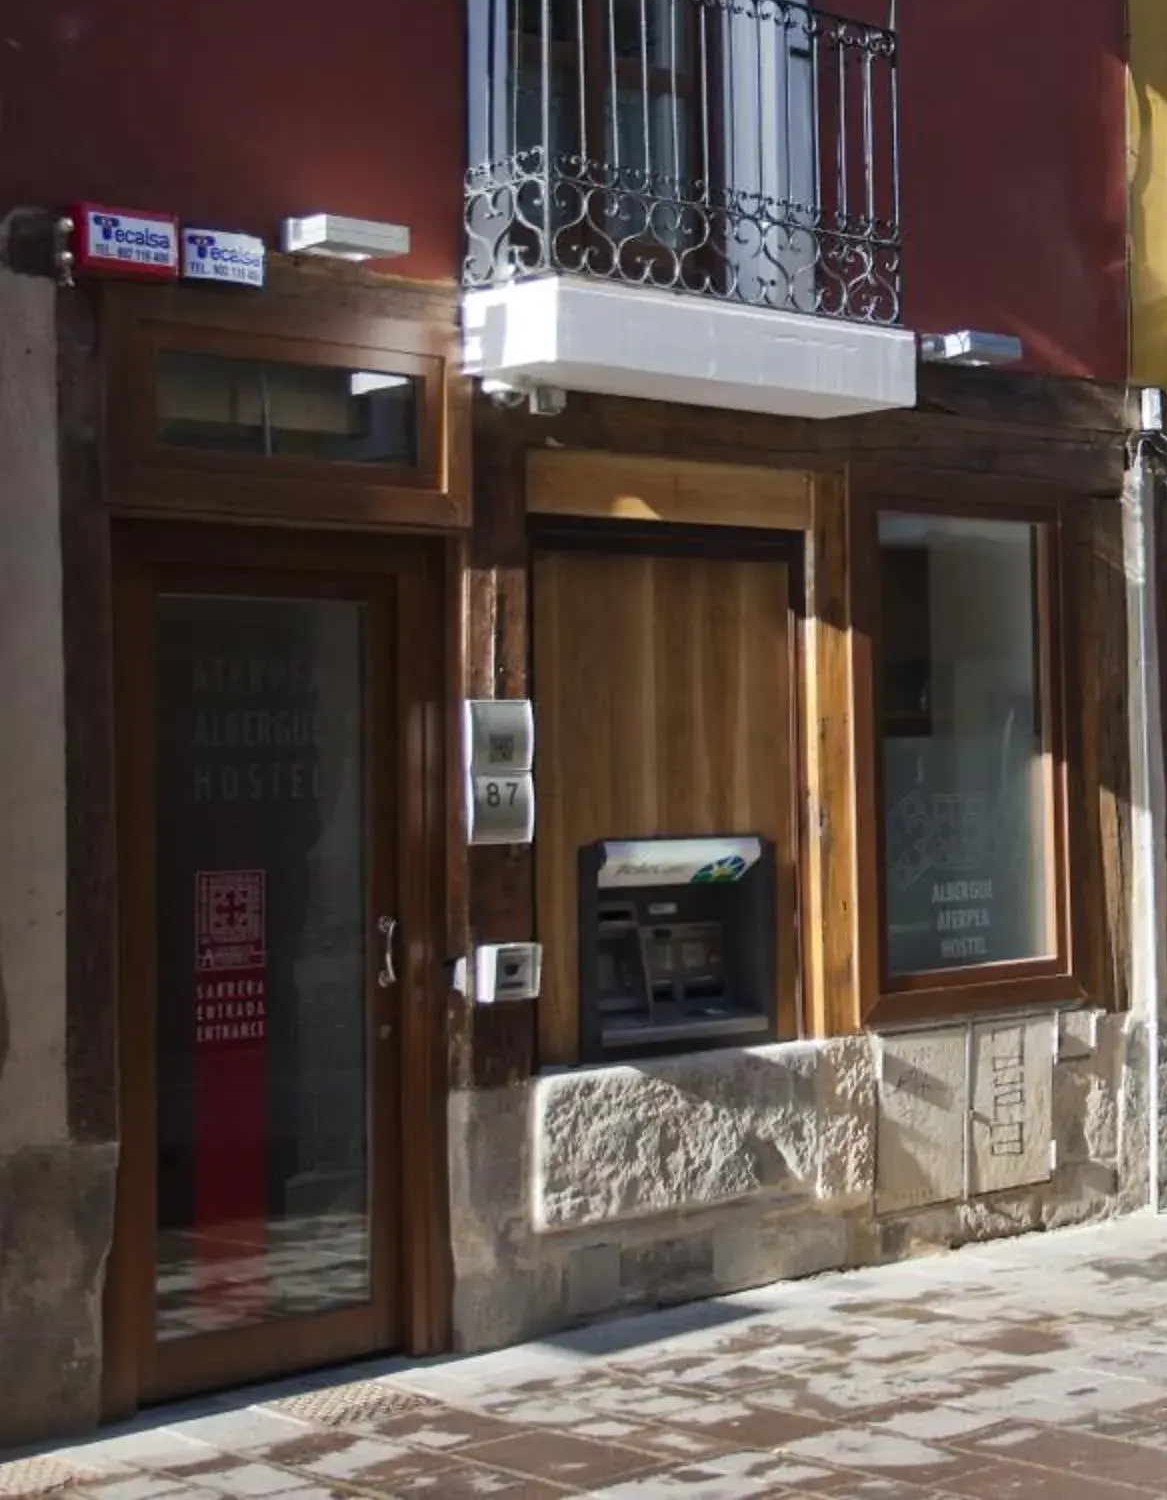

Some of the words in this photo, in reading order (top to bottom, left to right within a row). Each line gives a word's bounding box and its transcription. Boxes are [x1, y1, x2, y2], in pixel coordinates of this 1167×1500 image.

[94, 216, 170, 250] Tecalsa
[188, 235, 261, 268] Tecalsa
[191, 709, 325, 748] ALBERGUE
[193, 761, 327, 802] HOSTEL
[485, 781, 518, 808] 87
[932, 876, 993, 904] ALBERGUE
[937, 908, 990, 932] ATERPEA
[941, 936, 988, 959] HOSTEL
[196, 1000, 265, 1022] ENTRADA
[196, 1021, 265, 1043] ENTRANCE
